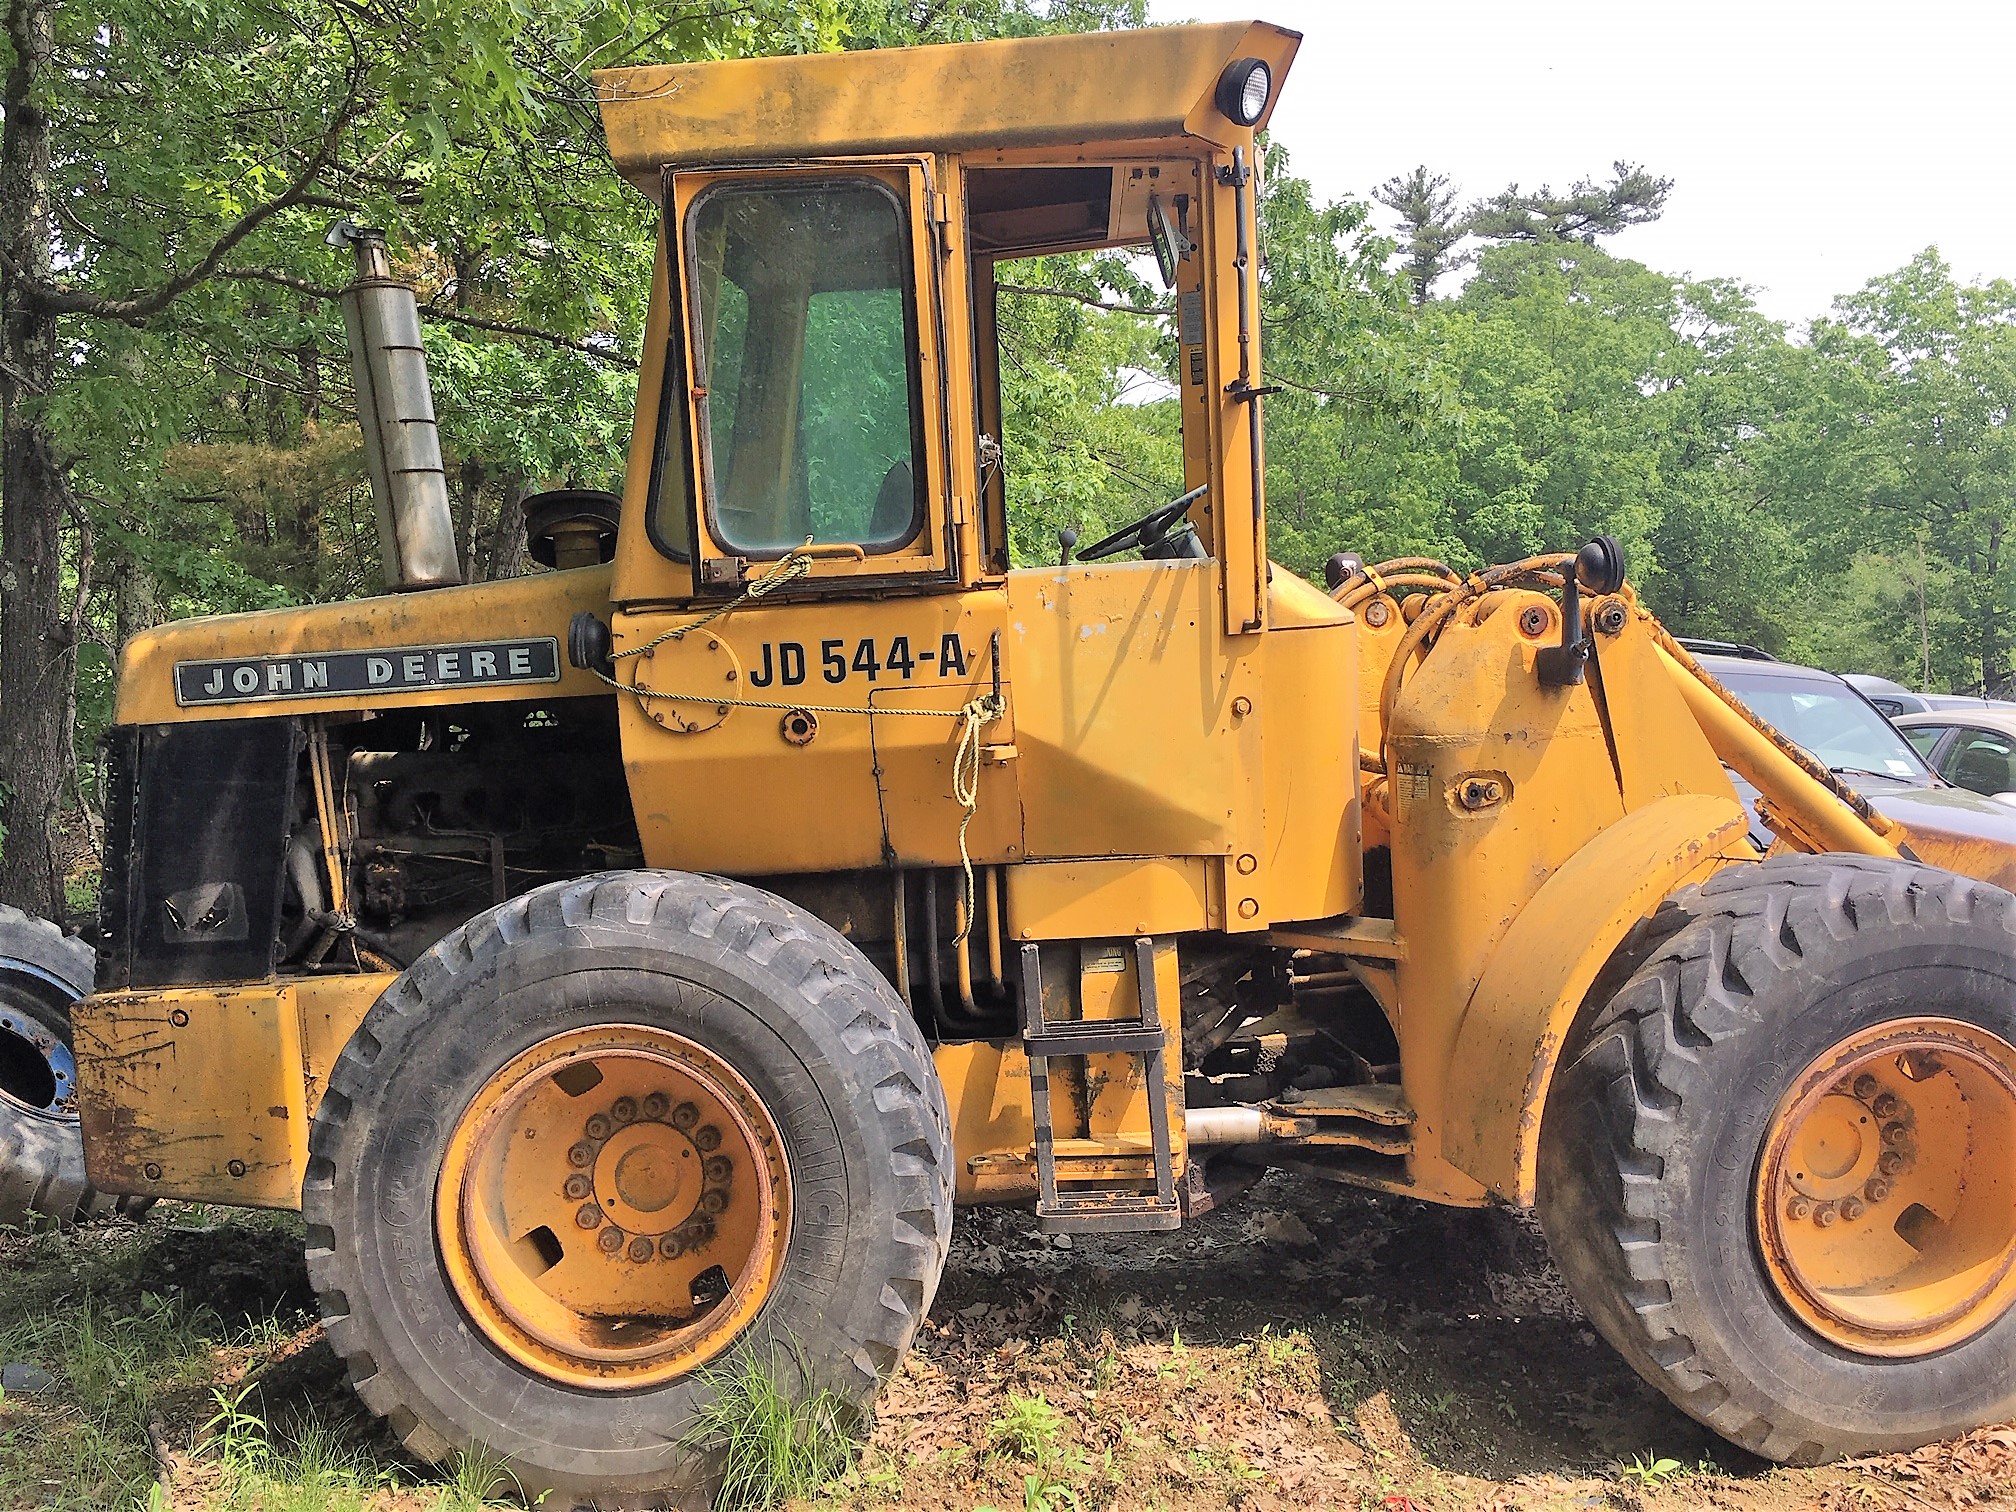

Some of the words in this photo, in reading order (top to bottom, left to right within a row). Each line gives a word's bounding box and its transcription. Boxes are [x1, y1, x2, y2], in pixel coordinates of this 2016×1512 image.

[204, 661, 328, 695] JOHN
[367, 648, 531, 684] DEERE
[750, 642, 806, 687] JD
[821, 634, 967, 683] 544-A
